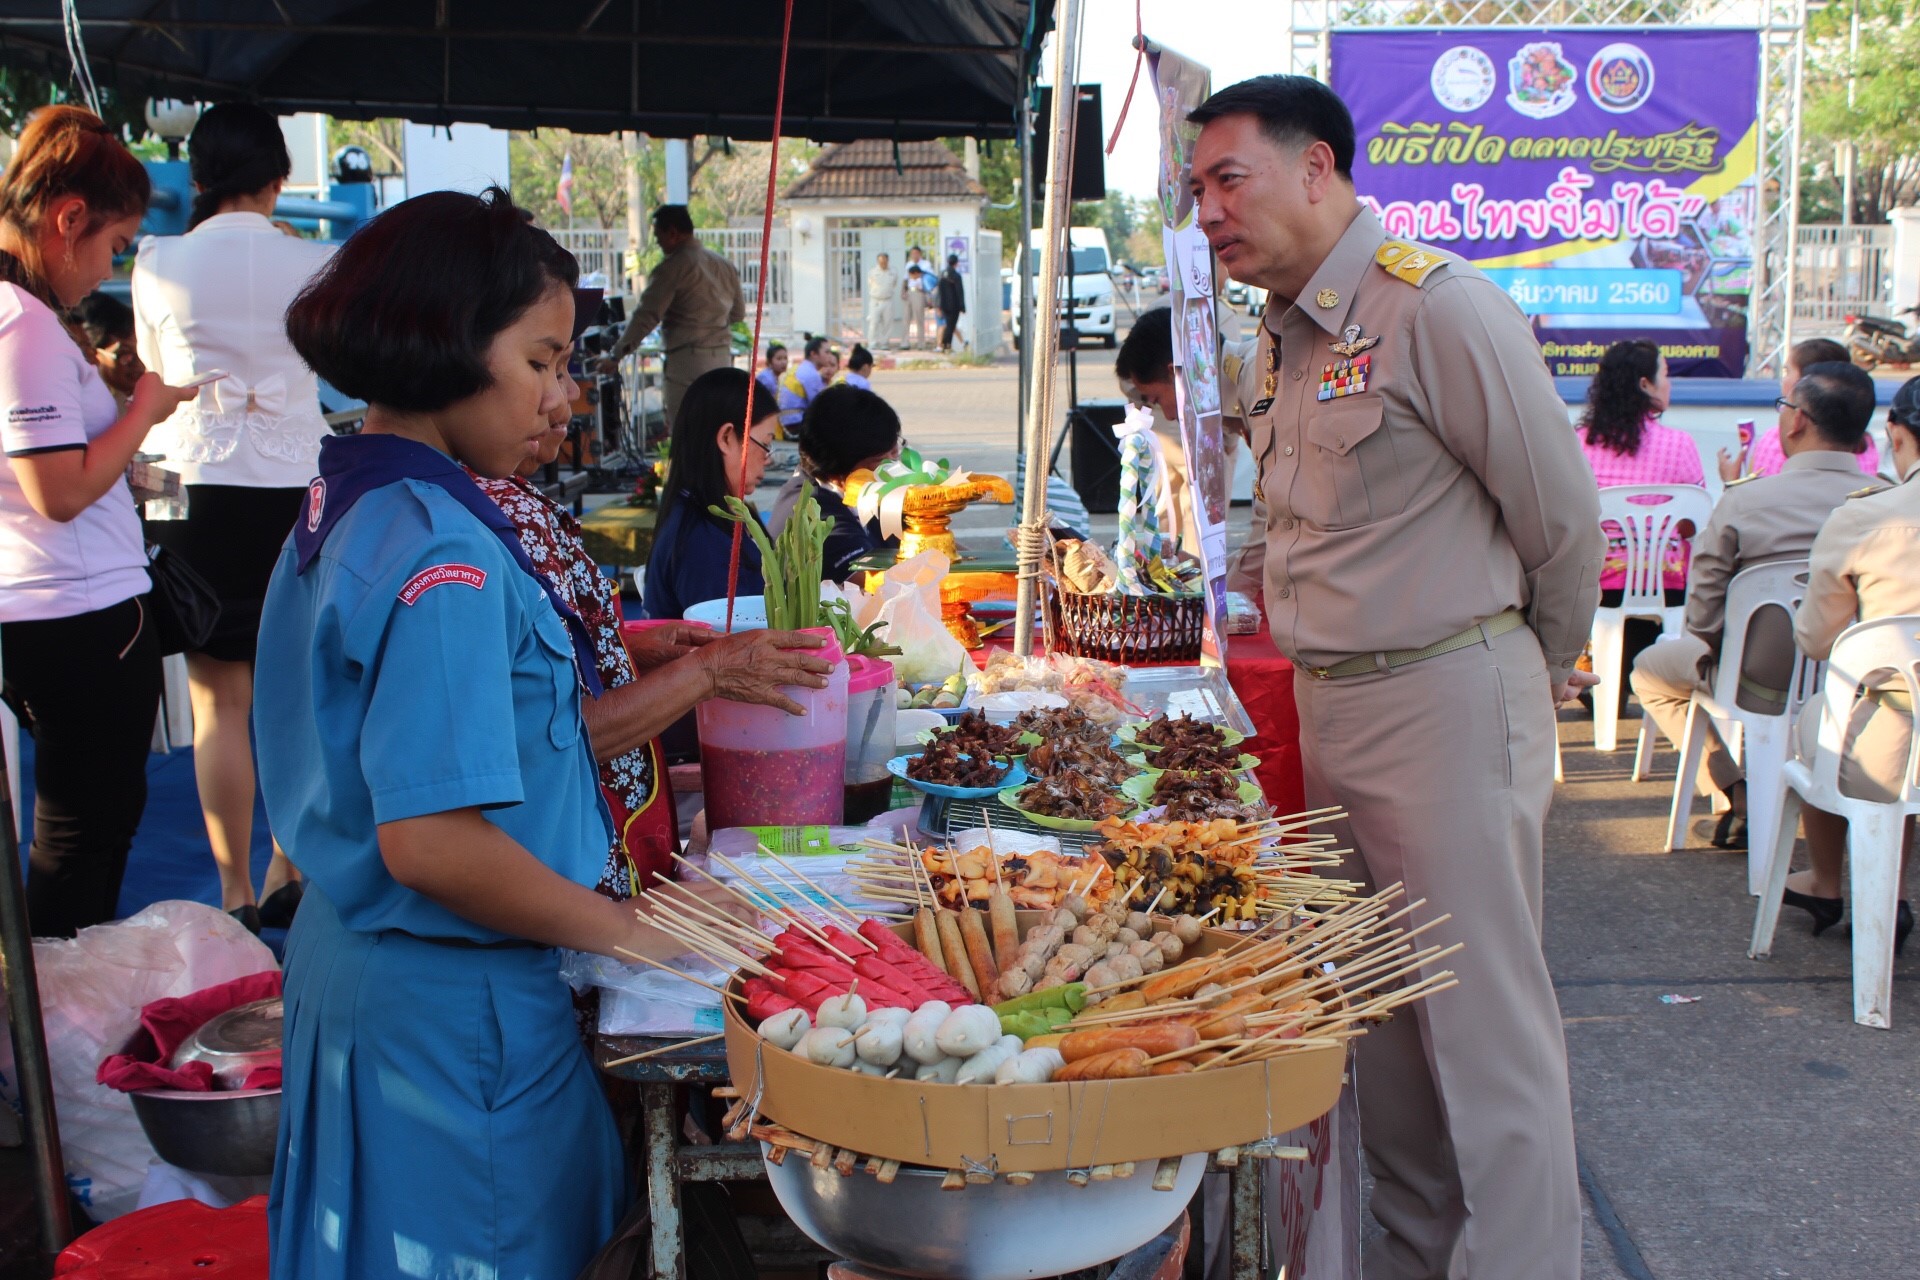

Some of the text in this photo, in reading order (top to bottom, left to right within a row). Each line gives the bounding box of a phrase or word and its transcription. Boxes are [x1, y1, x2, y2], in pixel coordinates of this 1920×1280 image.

[1367, 121, 1725, 173] พิธีเปิด ตลาดประชารัฐ
[1609, 281, 1671, 305] 2560
